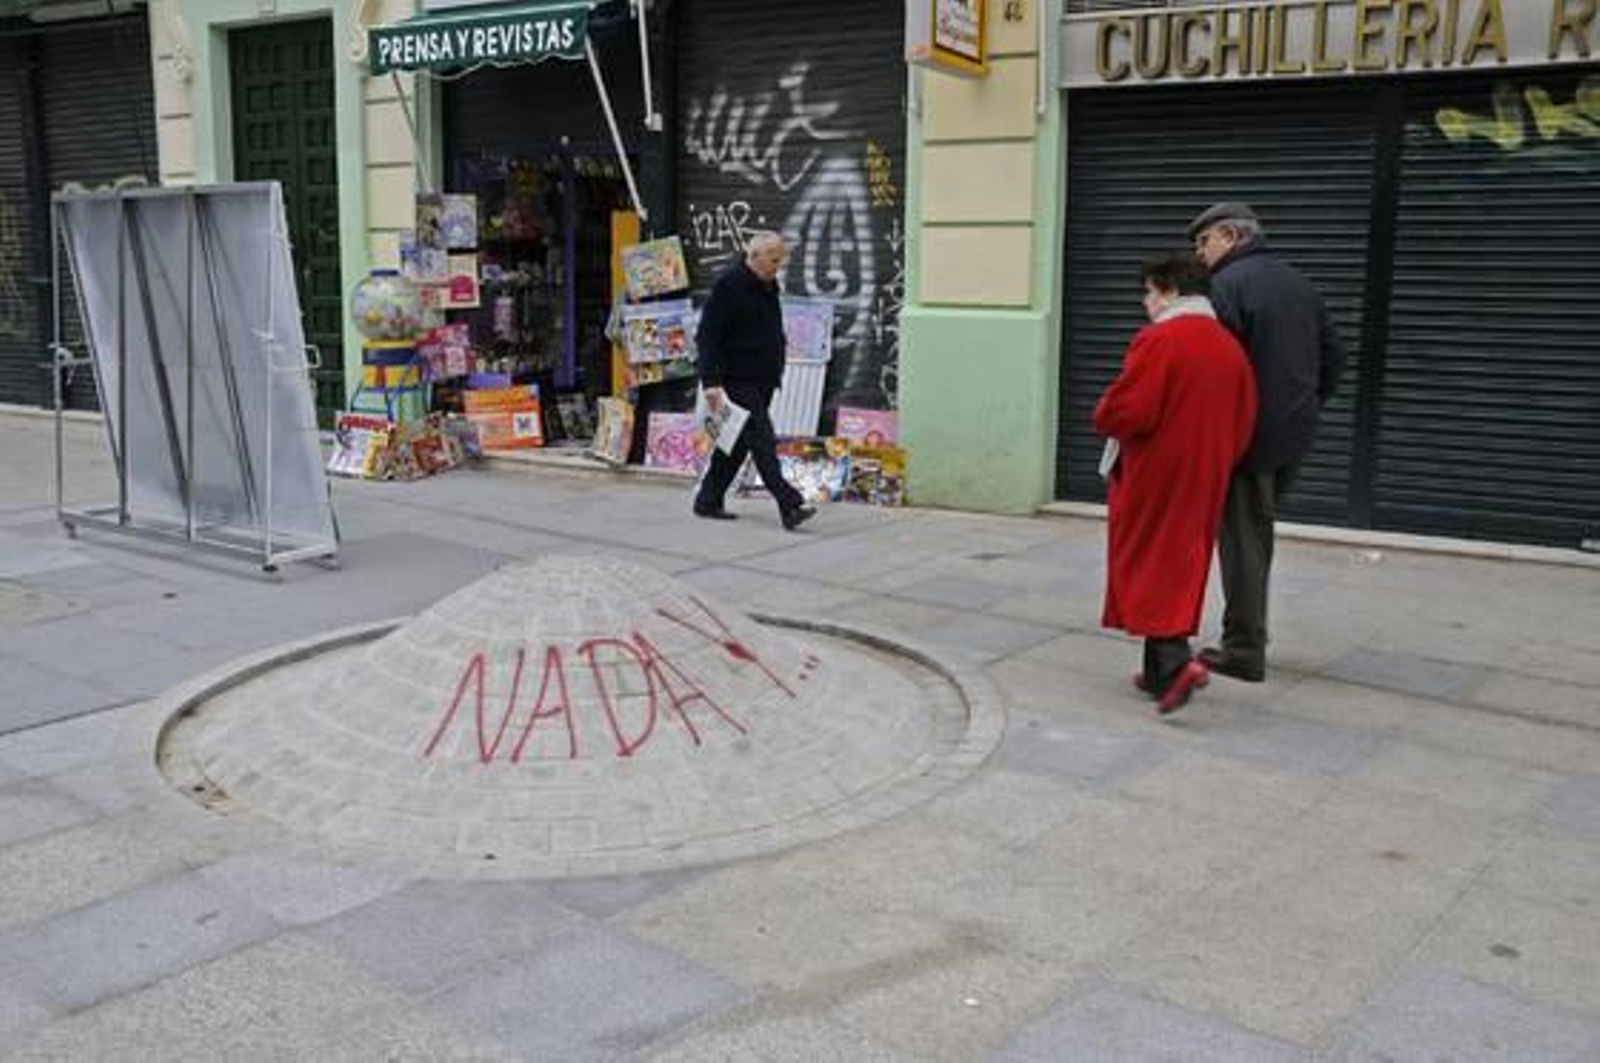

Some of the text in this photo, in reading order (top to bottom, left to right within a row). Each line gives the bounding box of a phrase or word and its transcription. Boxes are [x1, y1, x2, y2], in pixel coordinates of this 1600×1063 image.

[378, 18, 575, 65] PRENSA Y REVISTAS
[1095, 0, 1508, 82] CUCHILLERIA
[423, 630, 748, 764] NADA
